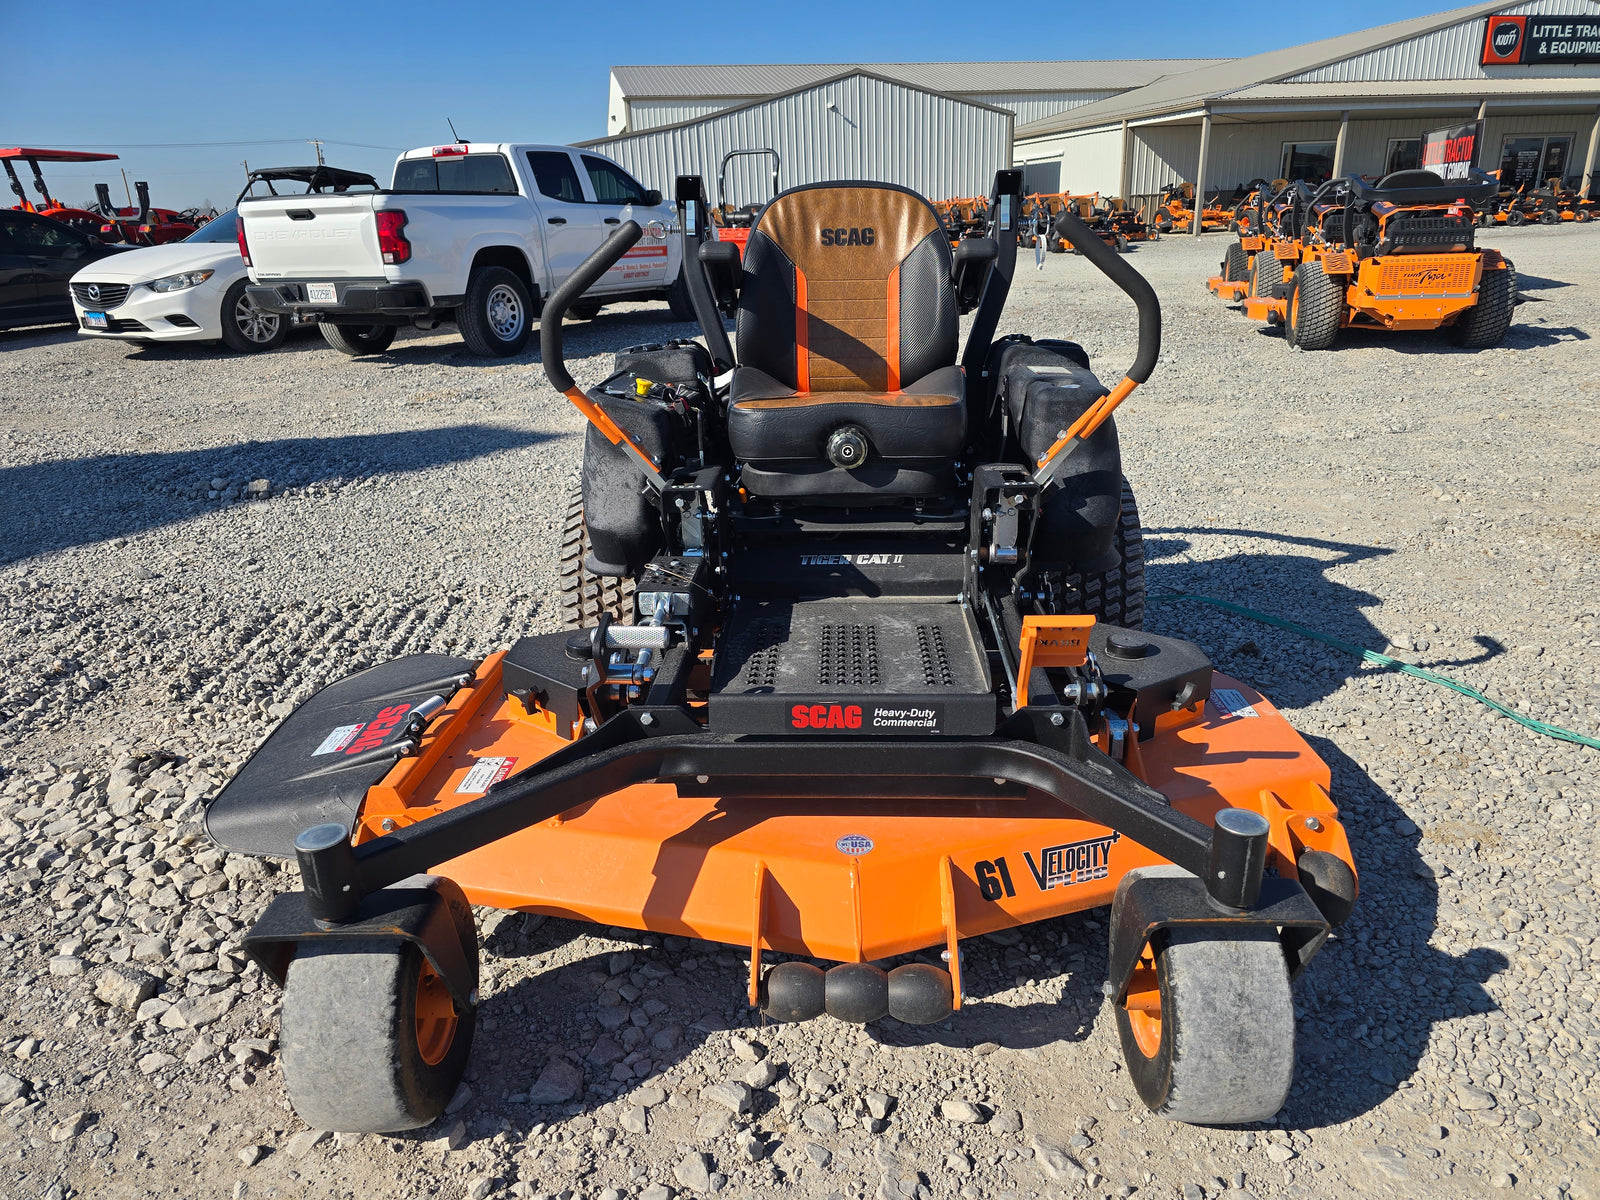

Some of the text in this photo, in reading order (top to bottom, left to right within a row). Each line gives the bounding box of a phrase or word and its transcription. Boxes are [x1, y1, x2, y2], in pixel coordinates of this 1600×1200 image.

[1533, 25, 1600, 37] LITTLE TRA
[1495, 34, 1517, 46] KIOTI
[1539, 42, 1547, 54] &
[1422, 141, 1443, 165] LITTLE
[254, 228, 358, 240] CHEVROLET
[821, 227, 874, 246] SCAG
[800, 554, 852, 565] TIGER
[791, 704, 936, 729] SCAG Heavy-Duty
[873, 717, 937, 727] Commercial
[345, 703, 412, 755] SCAG
[974, 857, 1016, 902] 61
[1048, 866, 1109, 889] PLUS
